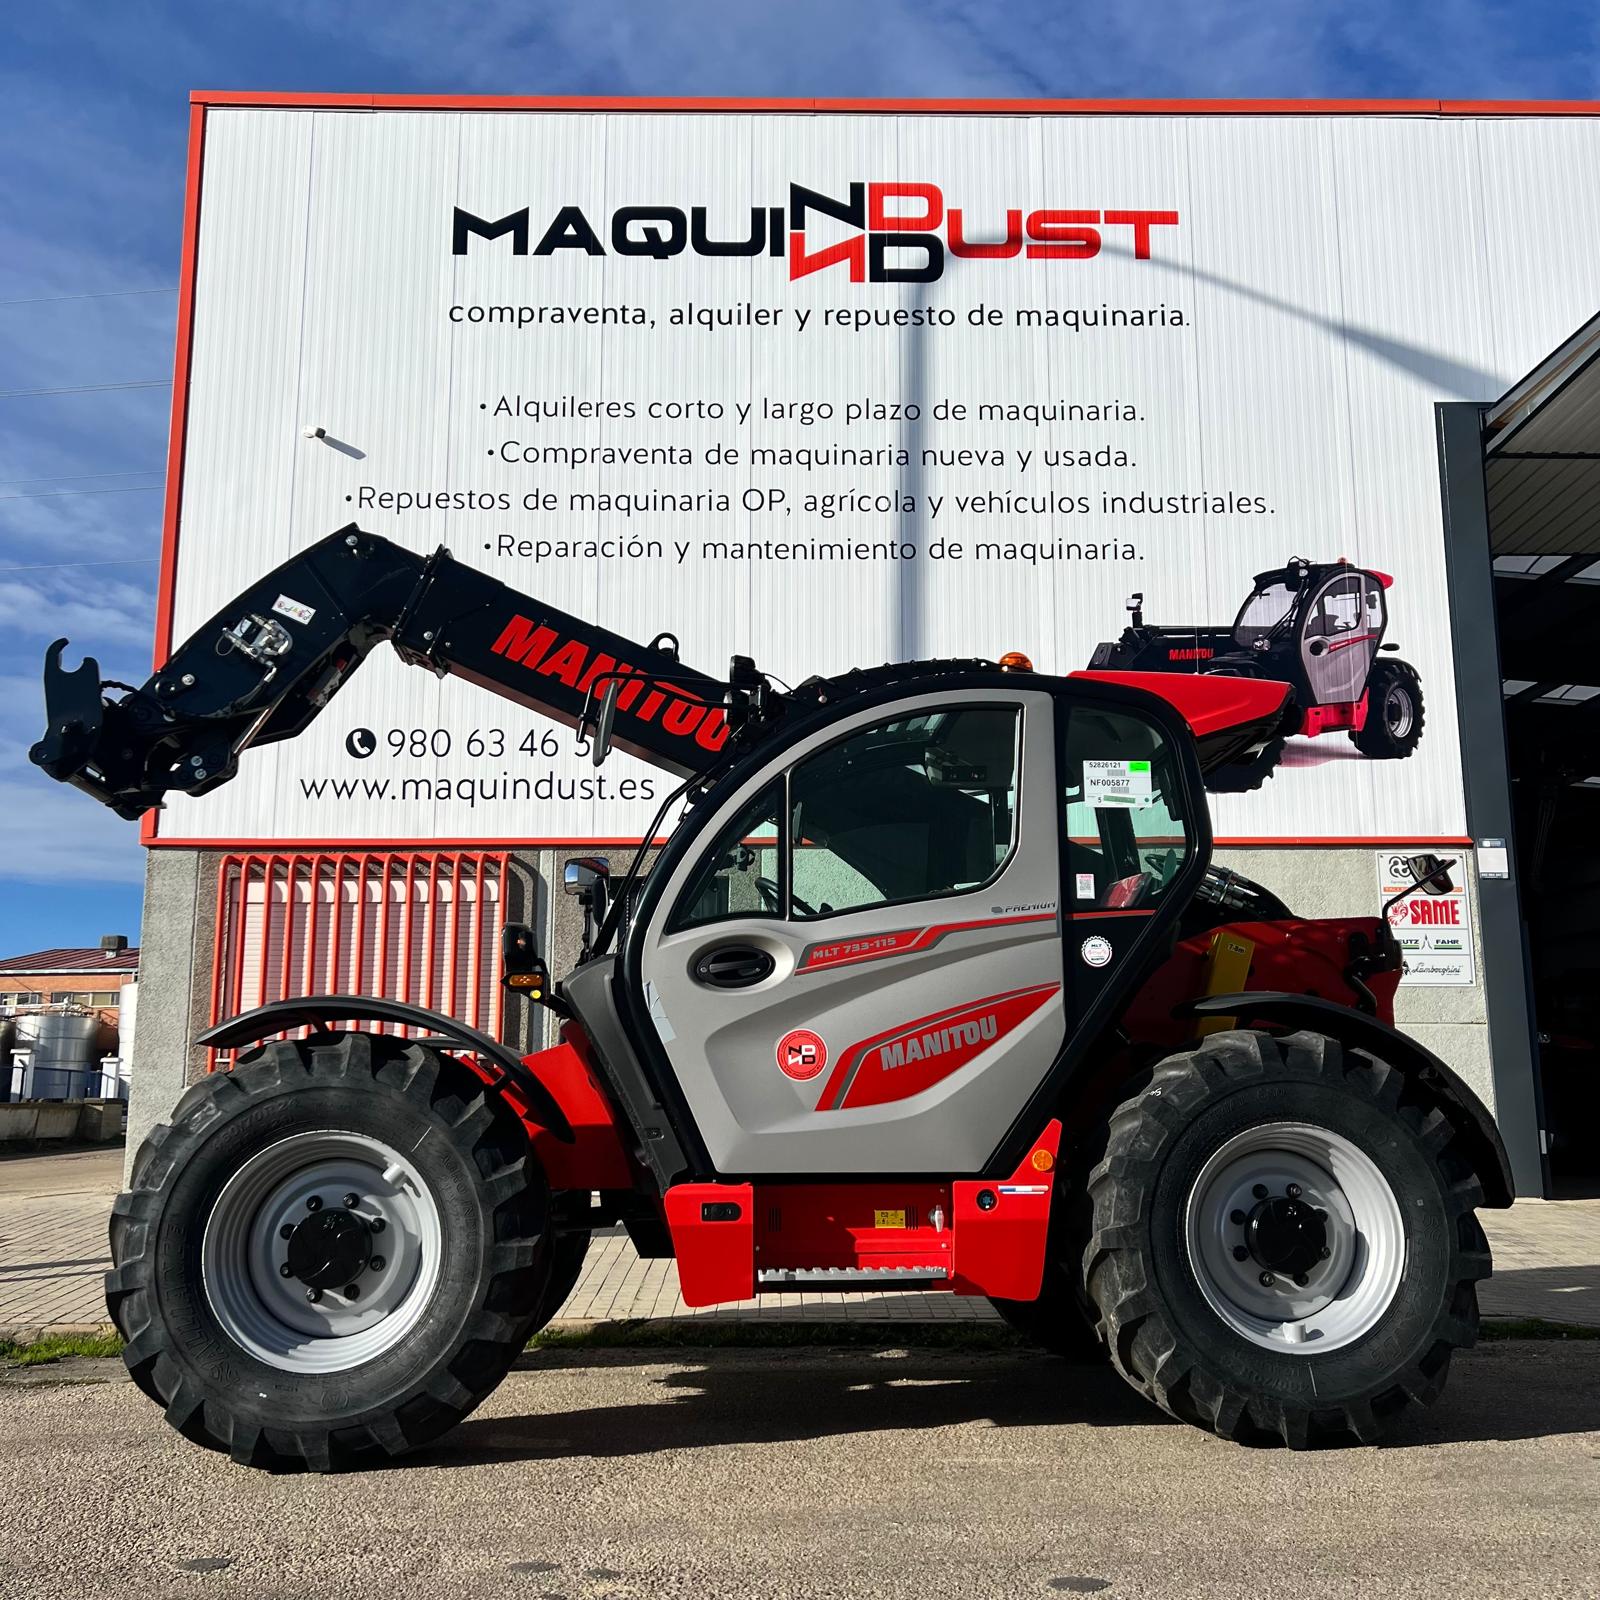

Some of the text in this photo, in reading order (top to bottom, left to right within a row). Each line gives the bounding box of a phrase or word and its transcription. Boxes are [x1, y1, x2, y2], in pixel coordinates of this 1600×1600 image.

[449, 302, 1193, 333] compraventa, alquiler y repuesto de maquinaria.
[493, 395, 1147, 427] Alquileres corto y largo plazo de maquinaria.
[500, 440, 1138, 473] Compraventa de maquinaria nueva y usada.
[358, 486, 1276, 519] Repuestos de maquinaria OP, agrícola y vehículos industriales.
[498, 534, 1144, 566] Reparación y mantenimiento de maquinaria.
[1169, 648, 1214, 661] MANITOU
[490, 614, 731, 752] MANITOU
[386, 728, 613, 759] 980 63 46 5
[299, 770, 656, 809] www.maquindust.es
[1410, 899, 1460, 924] SAME
[813, 937, 897, 959] MLT 733-115
[880, 1015, 998, 1071] MANITOU
